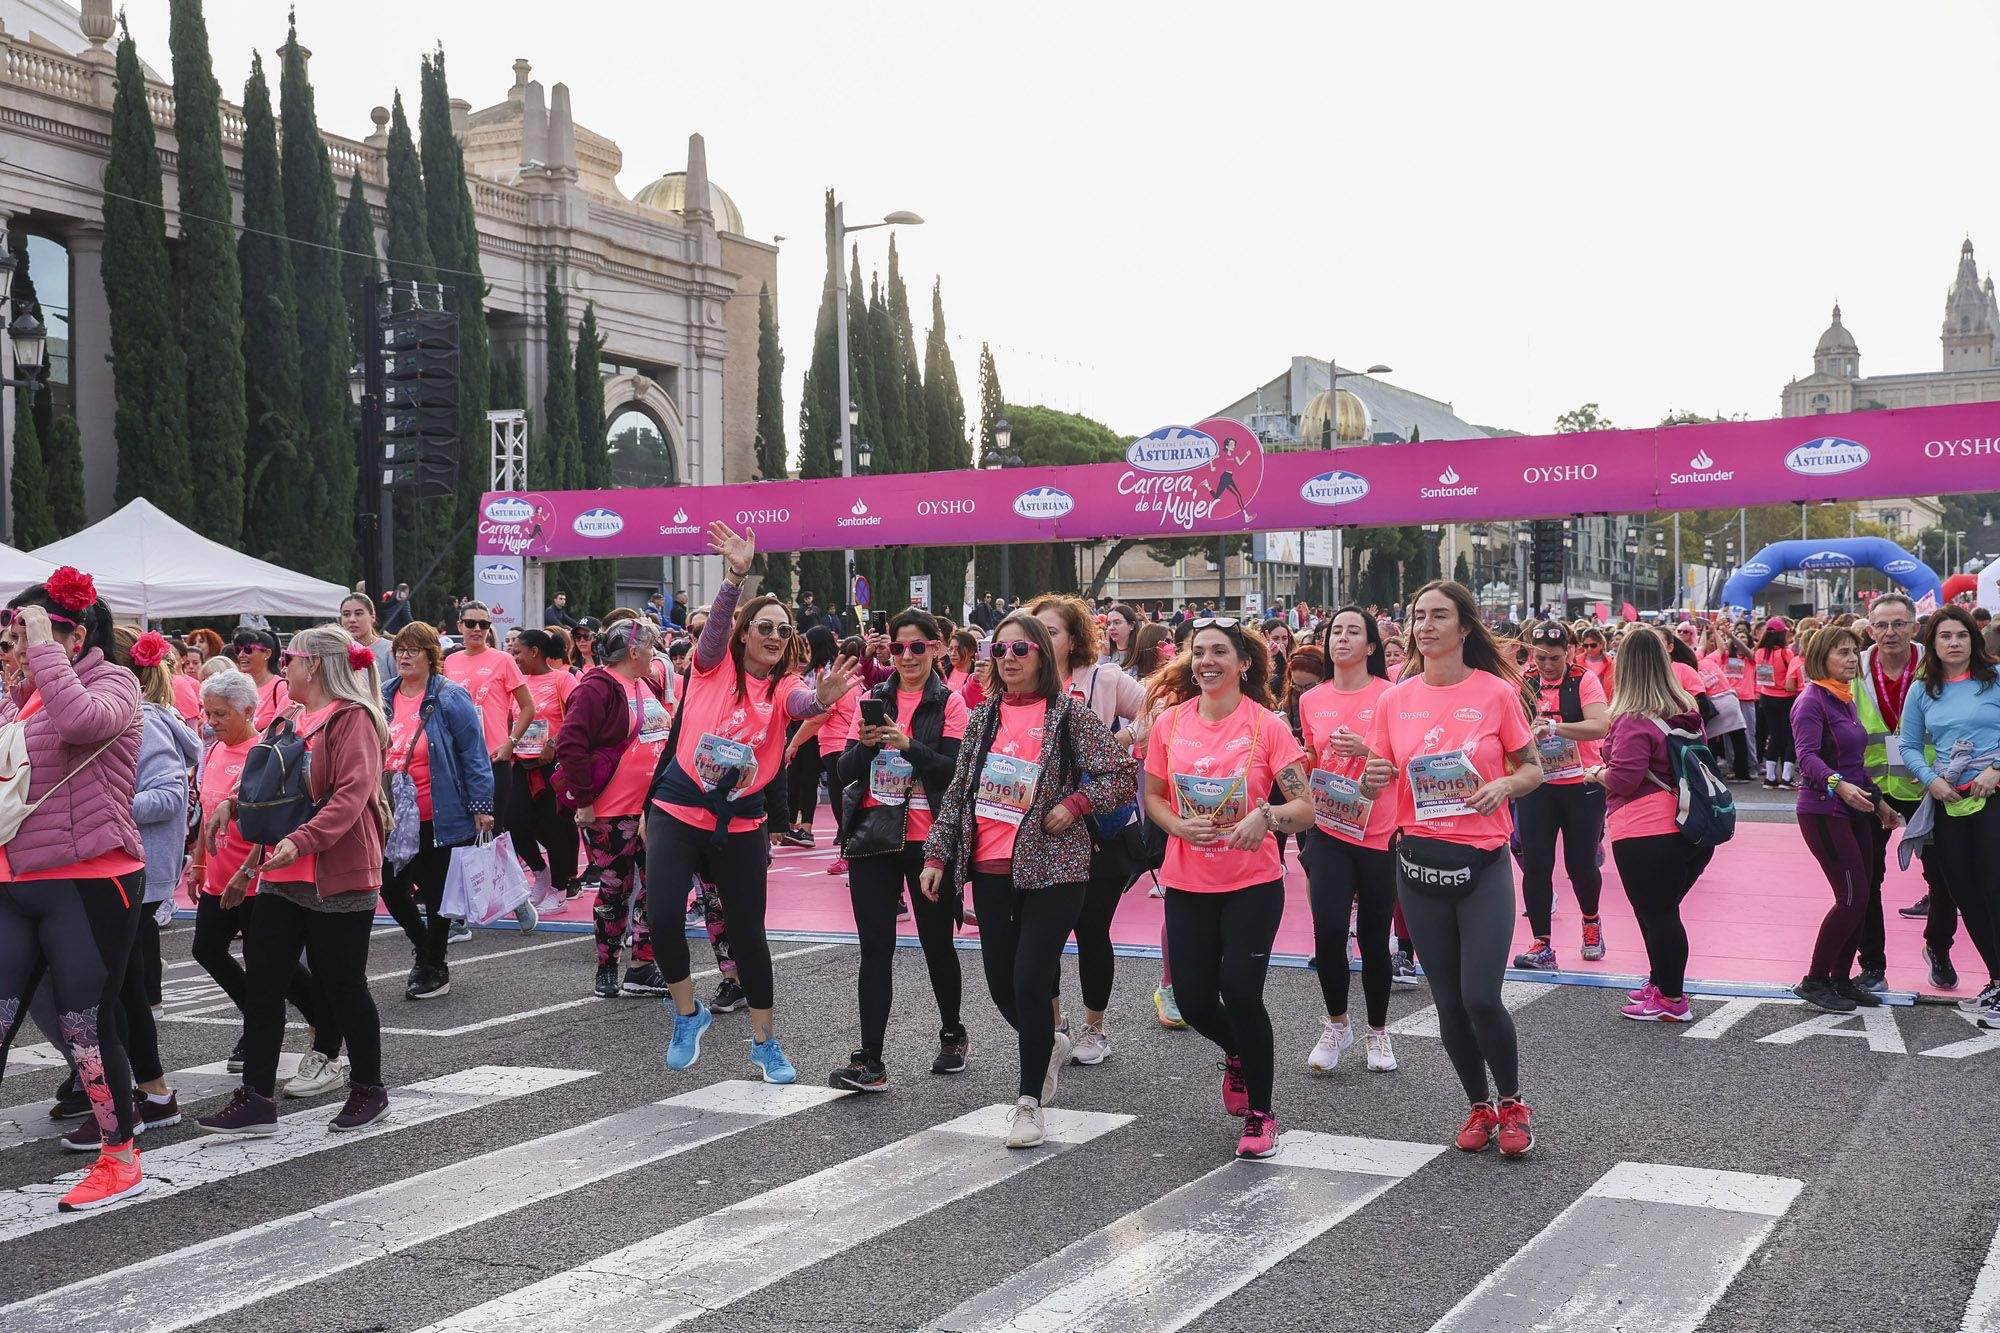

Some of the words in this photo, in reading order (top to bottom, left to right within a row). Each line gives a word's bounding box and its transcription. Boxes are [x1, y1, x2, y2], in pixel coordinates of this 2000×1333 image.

[1133, 445, 1211, 462] ASTURIANA
[1792, 453, 1863, 467] ASTURIANA
[1523, 463, 1598, 483] OYSHO
[1670, 470, 1735, 484] Santander
[1117, 471, 1192, 495] Carrera
[1306, 485, 1364, 498] ASTURIANA
[1420, 486, 1478, 498] Santander
[489, 506, 530, 517] ASTURIANA
[917, 499, 975, 516] OYSHO
[1018, 500, 1069, 512] ASTURIANA
[1135, 496, 1149, 512] de
[1151, 495, 1162, 511] la
[1160, 490, 1221, 529] Mujer
[736, 508, 790, 525] OYSHO
[837, 516, 882, 527] Santander
[479, 521, 520, 535] Carrera
[577, 519, 620, 530] ASTURIANA
[660, 525, 701, 535] Santander
[488, 536, 496, 544] de
[502, 534, 534, 554] Mujer
[481, 570, 518, 580] ASTURIANA
[1400, 711, 1429, 720] OYSHO
[986, 782, 1011, 796] 016
[1437, 778, 1464, 791] 016
[1327, 798, 1349, 813] 016
